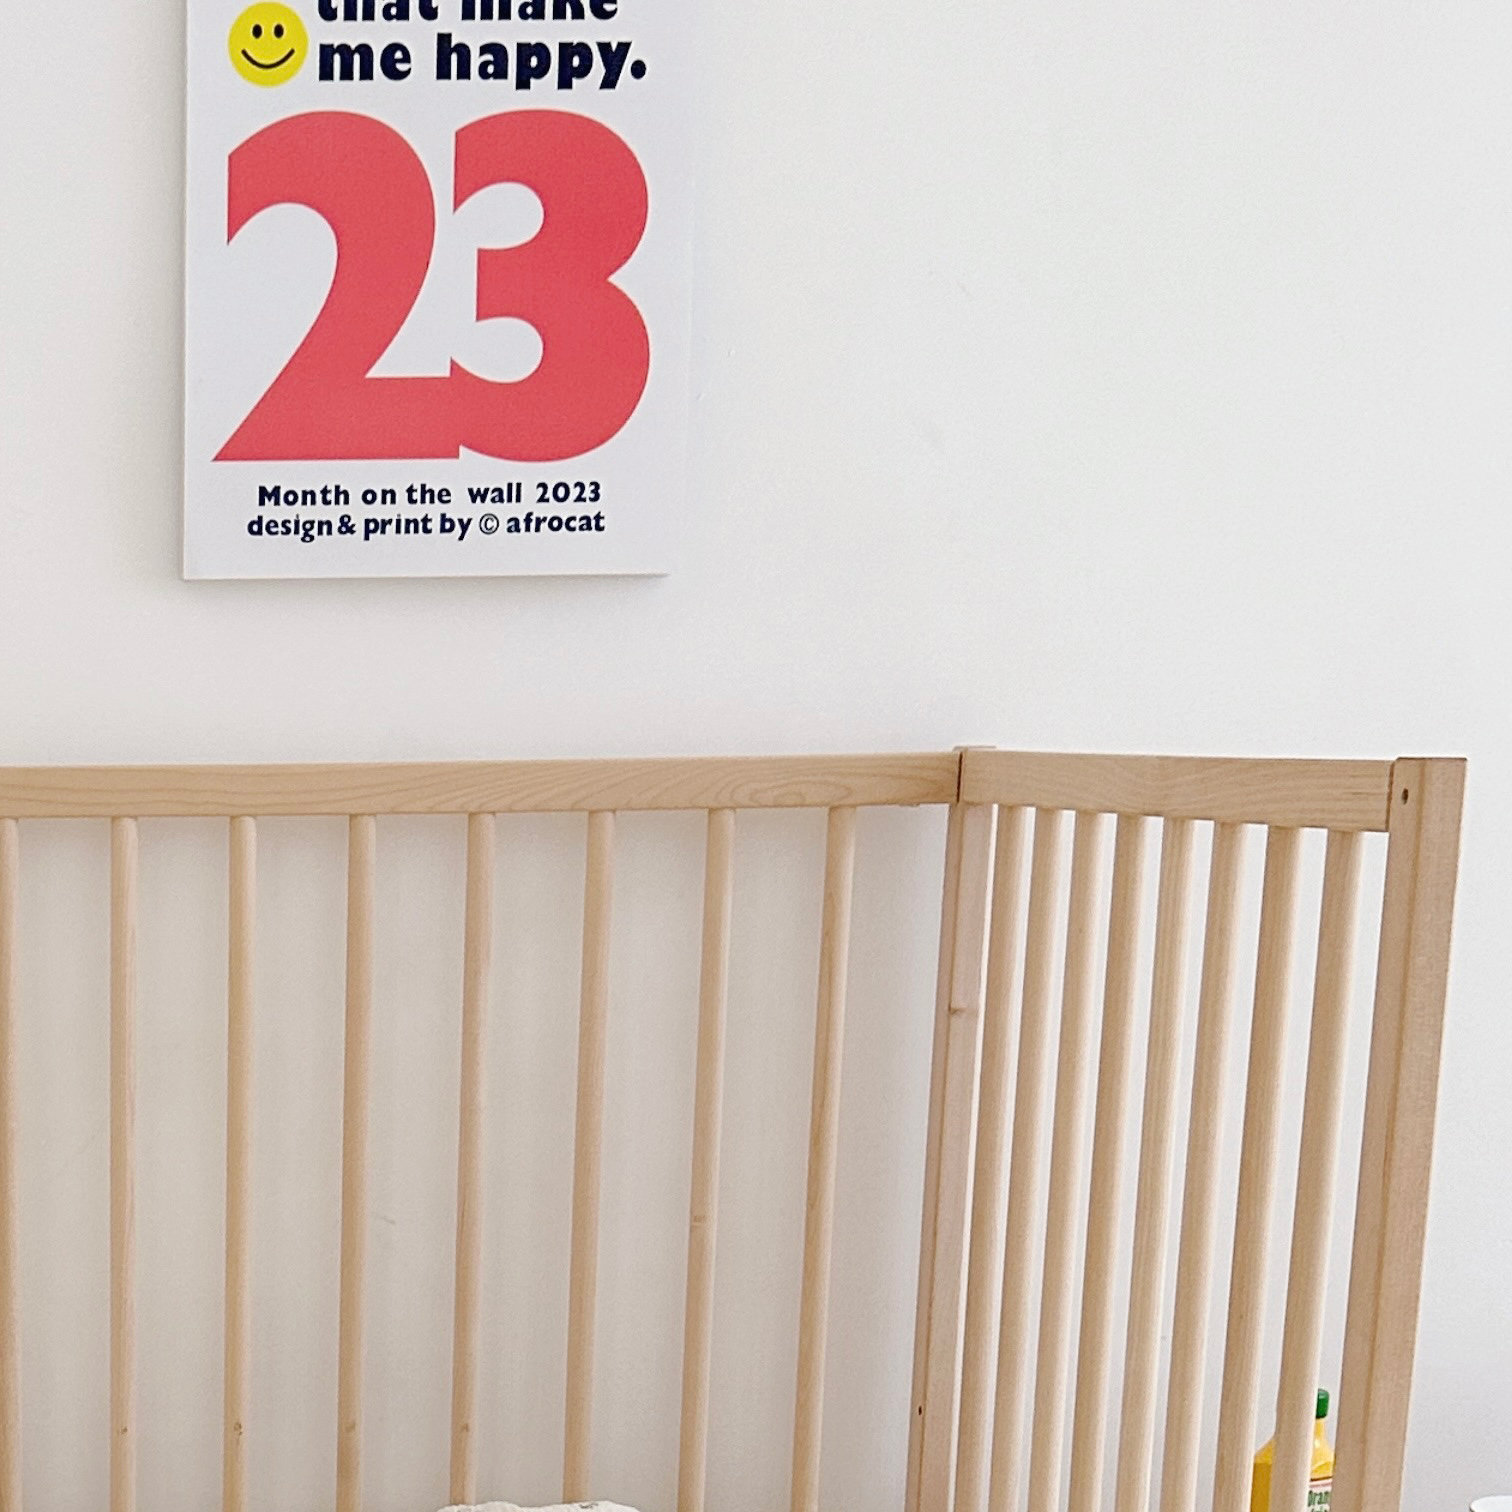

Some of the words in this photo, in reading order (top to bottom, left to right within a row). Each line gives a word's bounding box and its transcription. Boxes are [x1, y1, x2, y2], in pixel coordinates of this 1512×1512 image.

[318, 42, 412, 82] me
[435, 32, 647, 91] happy.
[211, 109, 651, 463] 23
[258, 484, 350, 507] Month
[361, 488, 397, 506] on
[405, 483, 452, 505] the
[467, 482, 522, 504] wall
[536, 481, 601, 504] 2023
[363, 513, 433, 542] print
[439, 512, 473, 542] by
[506, 511, 605, 534] afrocat
